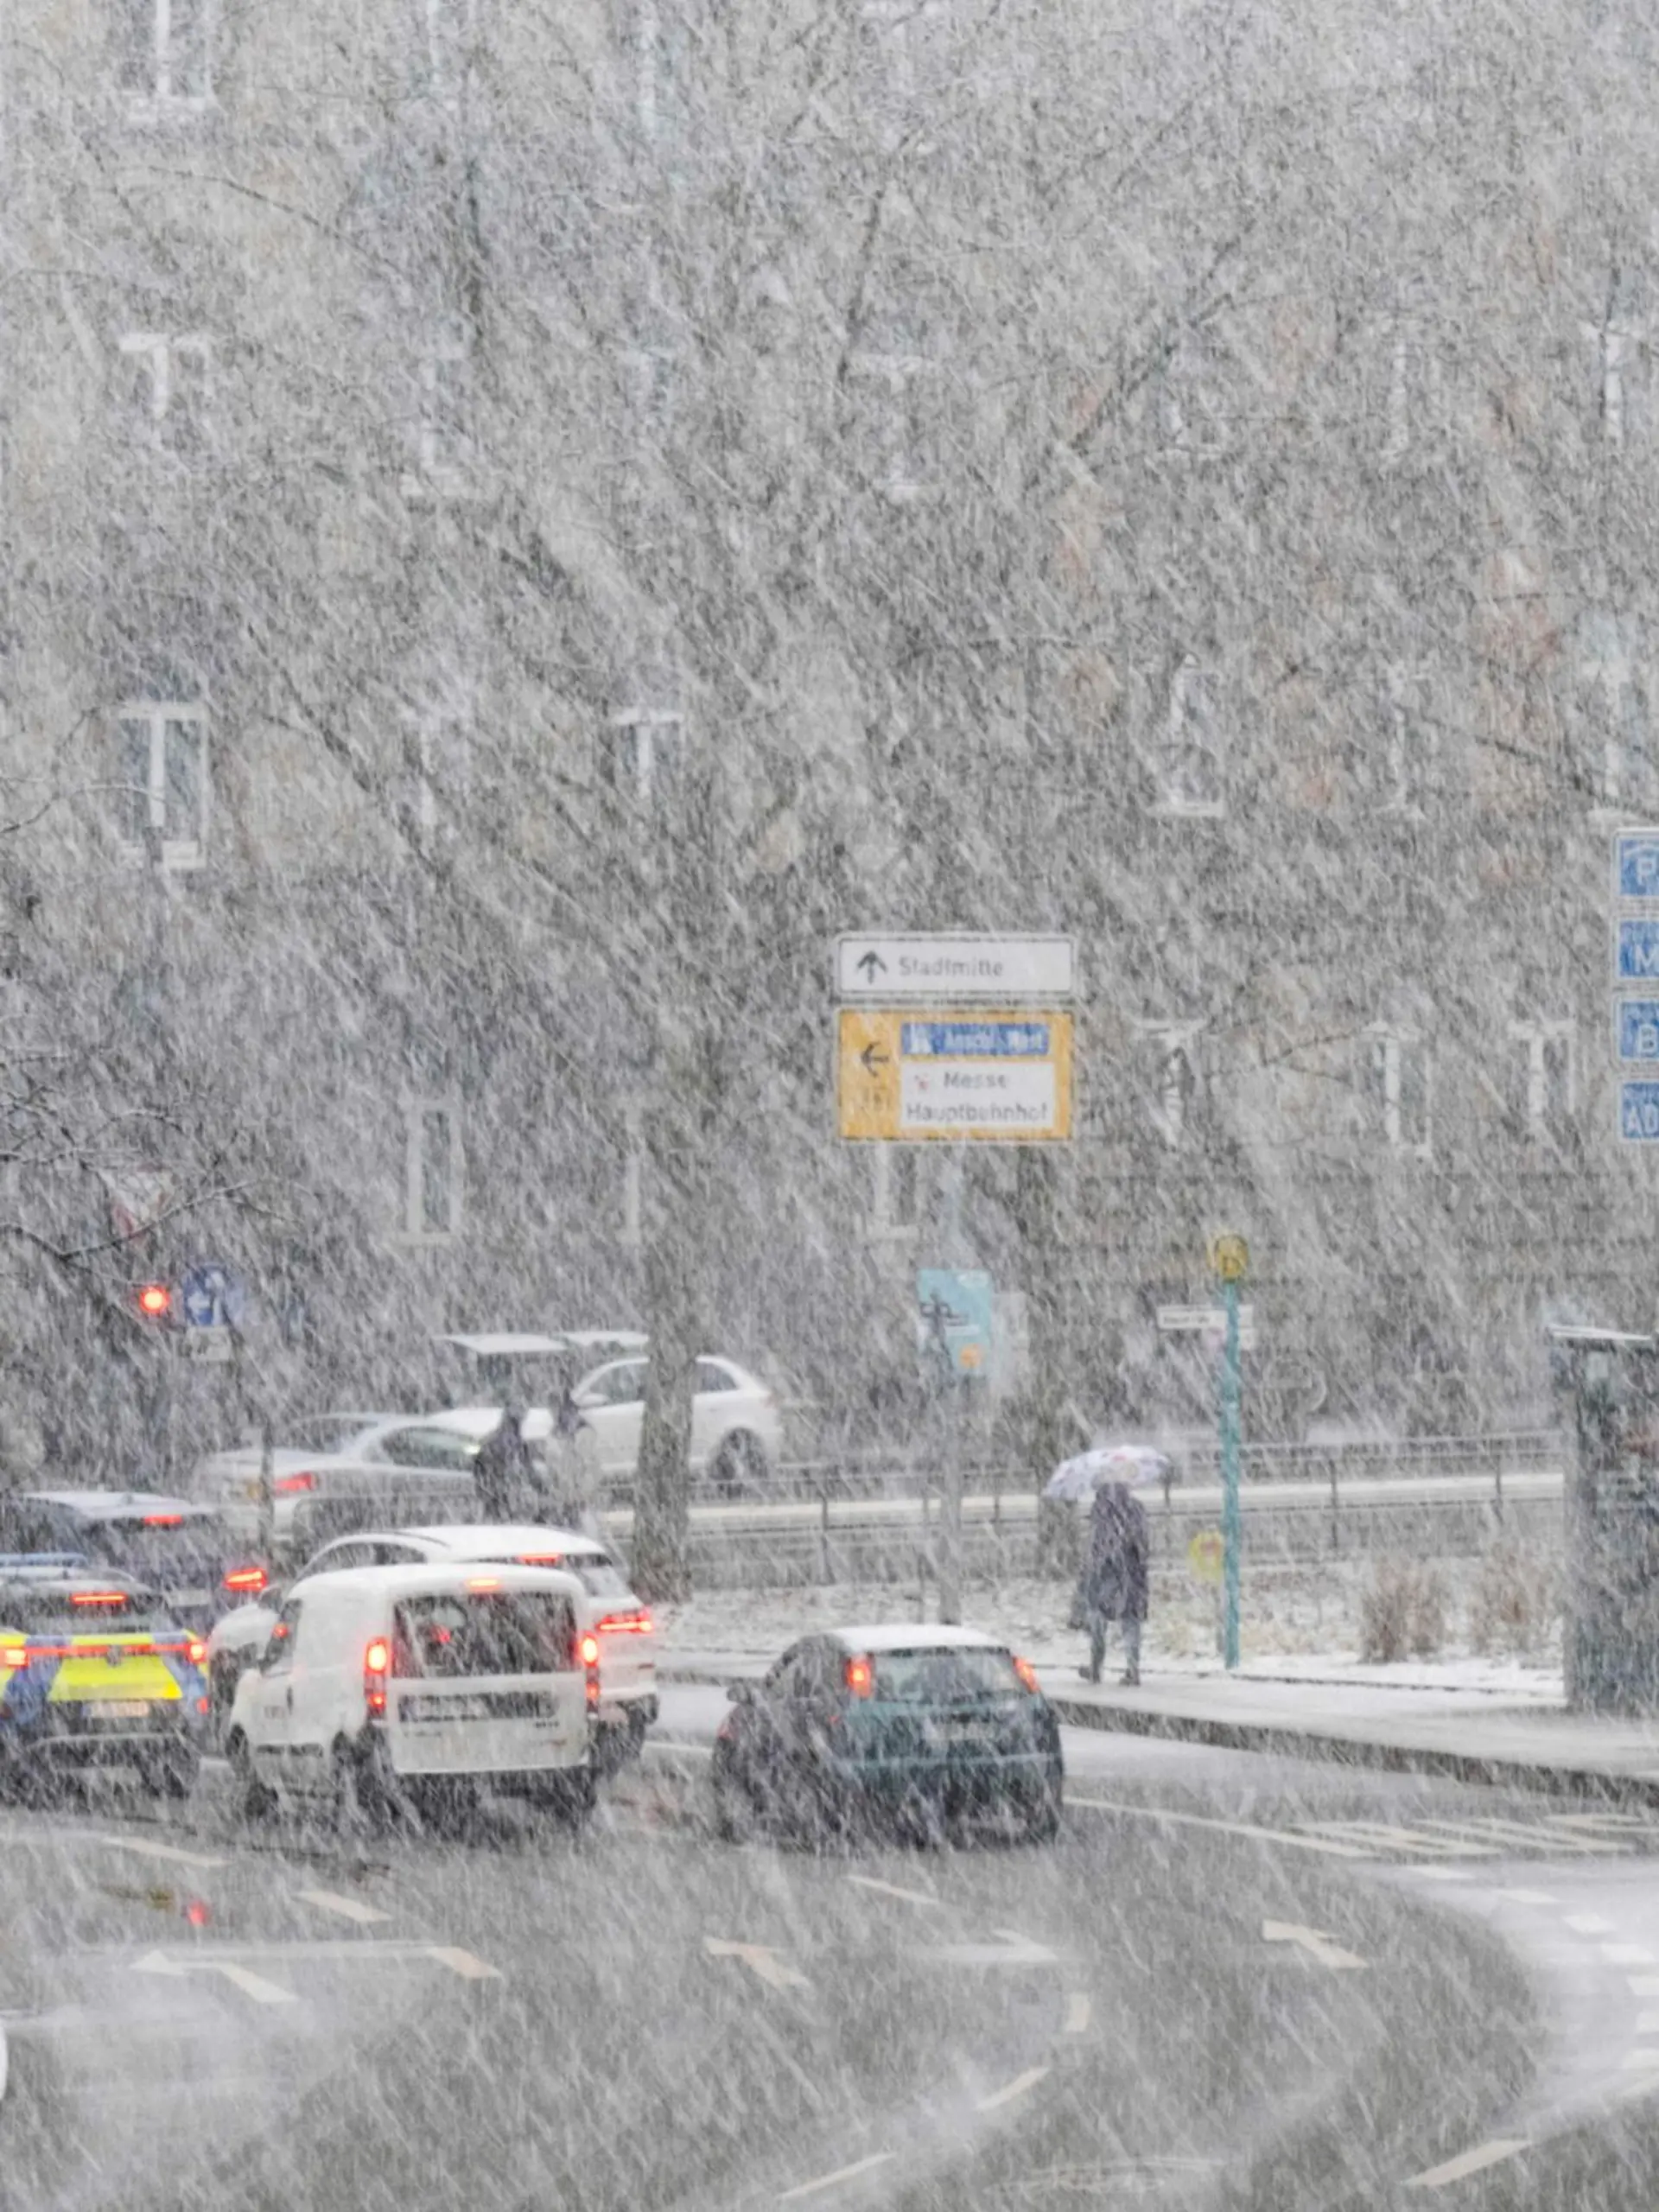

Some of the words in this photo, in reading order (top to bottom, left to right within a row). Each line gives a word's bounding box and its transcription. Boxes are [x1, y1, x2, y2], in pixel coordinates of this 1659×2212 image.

[899, 956, 1003, 977] Stadtmitte
[944, 1071, 1007, 1090] Messe
[906, 1102, 1048, 1122] Hauptbahnhof
